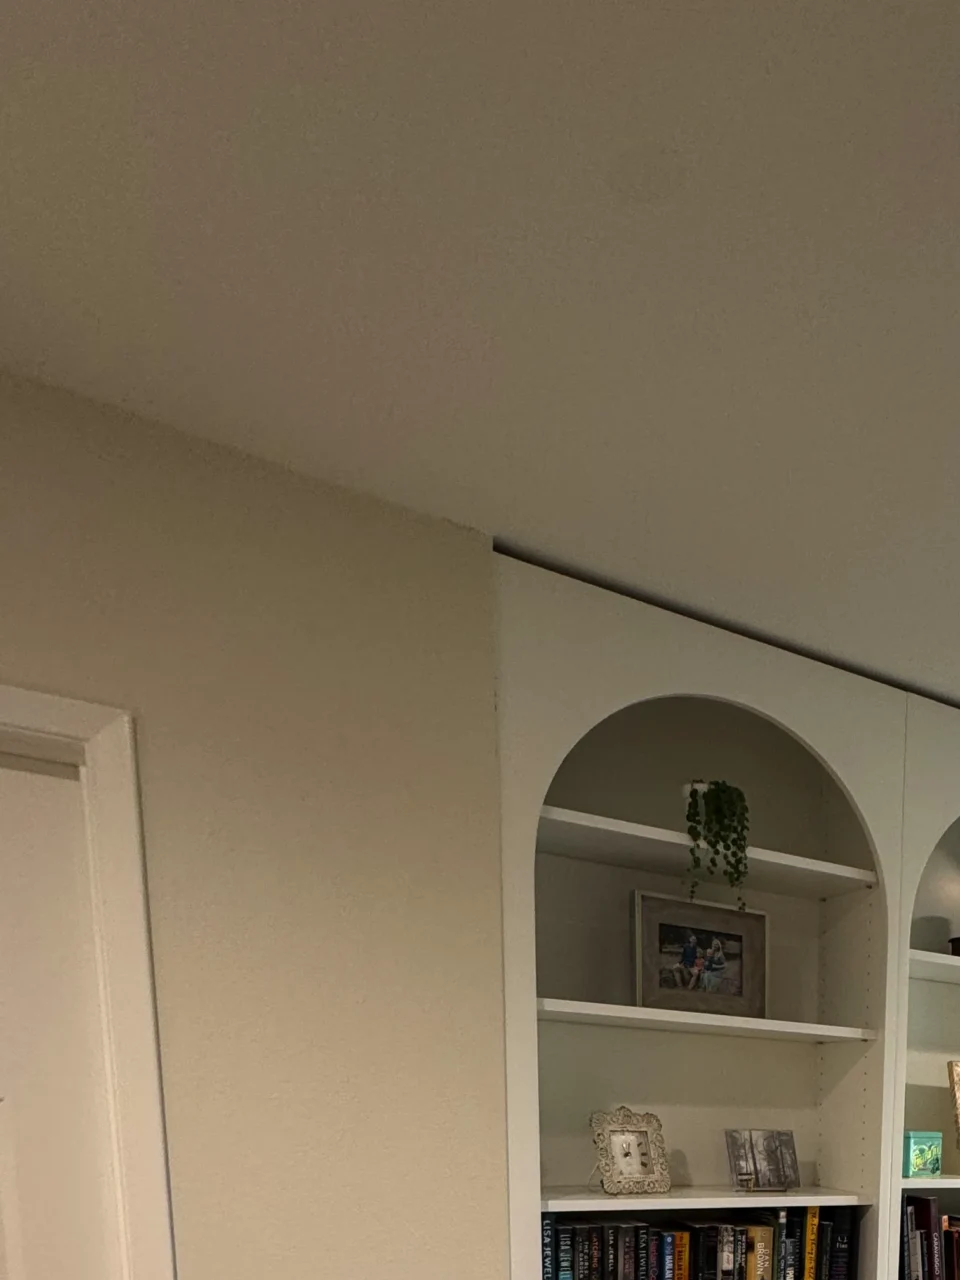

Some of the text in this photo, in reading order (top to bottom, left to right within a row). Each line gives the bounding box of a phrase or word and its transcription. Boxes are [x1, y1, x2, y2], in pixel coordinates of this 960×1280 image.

[543, 1220, 551, 1243] LISA
[560, 1235, 570, 1279] LISA JEWELL
[665, 1255, 673, 1278] HARLAN
[932, 1232, 940, 1276] CARAVAGGIO
